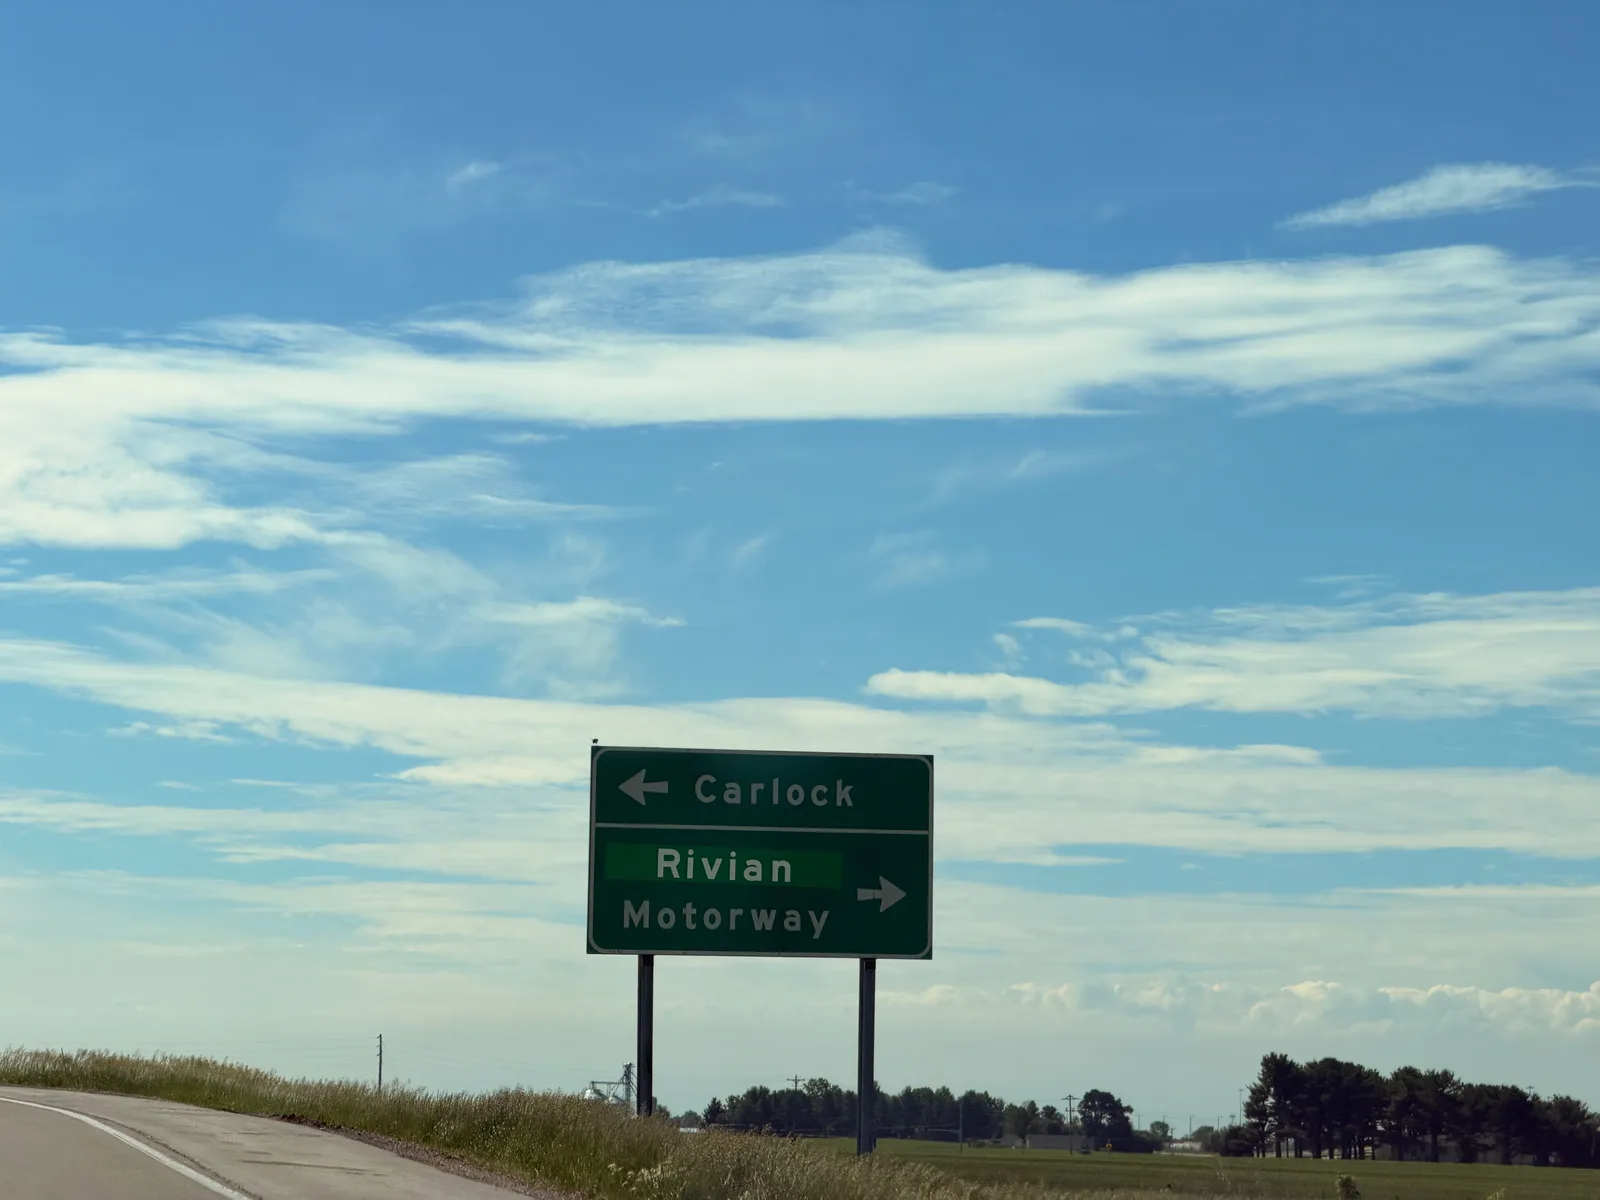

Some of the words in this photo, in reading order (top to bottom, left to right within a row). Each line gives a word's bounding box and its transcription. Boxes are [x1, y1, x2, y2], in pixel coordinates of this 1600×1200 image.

[694, 774, 854, 807] Carlock
[657, 848, 791, 882] Rivian
[623, 899, 830, 939] Motorway
